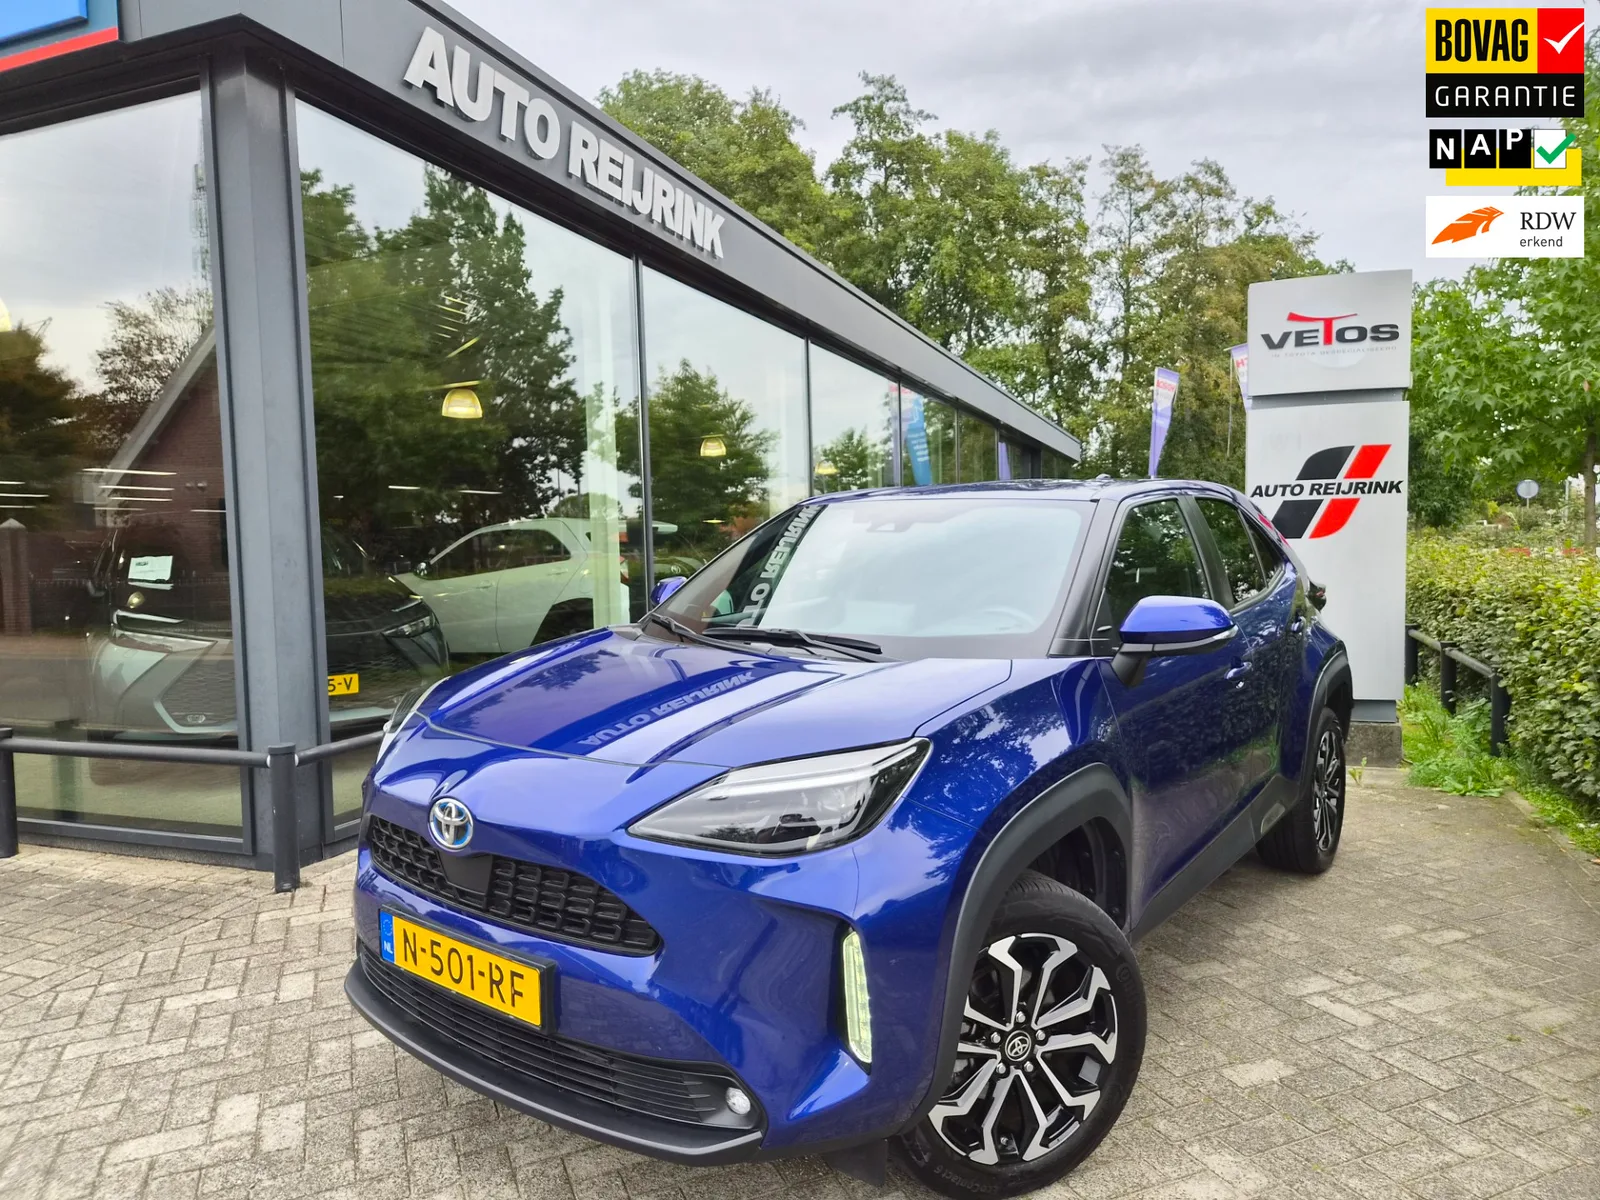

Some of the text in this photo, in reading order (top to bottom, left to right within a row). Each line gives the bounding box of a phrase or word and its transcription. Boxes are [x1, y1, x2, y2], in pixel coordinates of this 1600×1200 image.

[403, 26, 725, 259] AUTO REIJRINK
[1260, 311, 1400, 351] VETOS
[1250, 480, 1404, 498] AUTO REIJRINK
[402, 928, 524, 1007] N-501-RF
